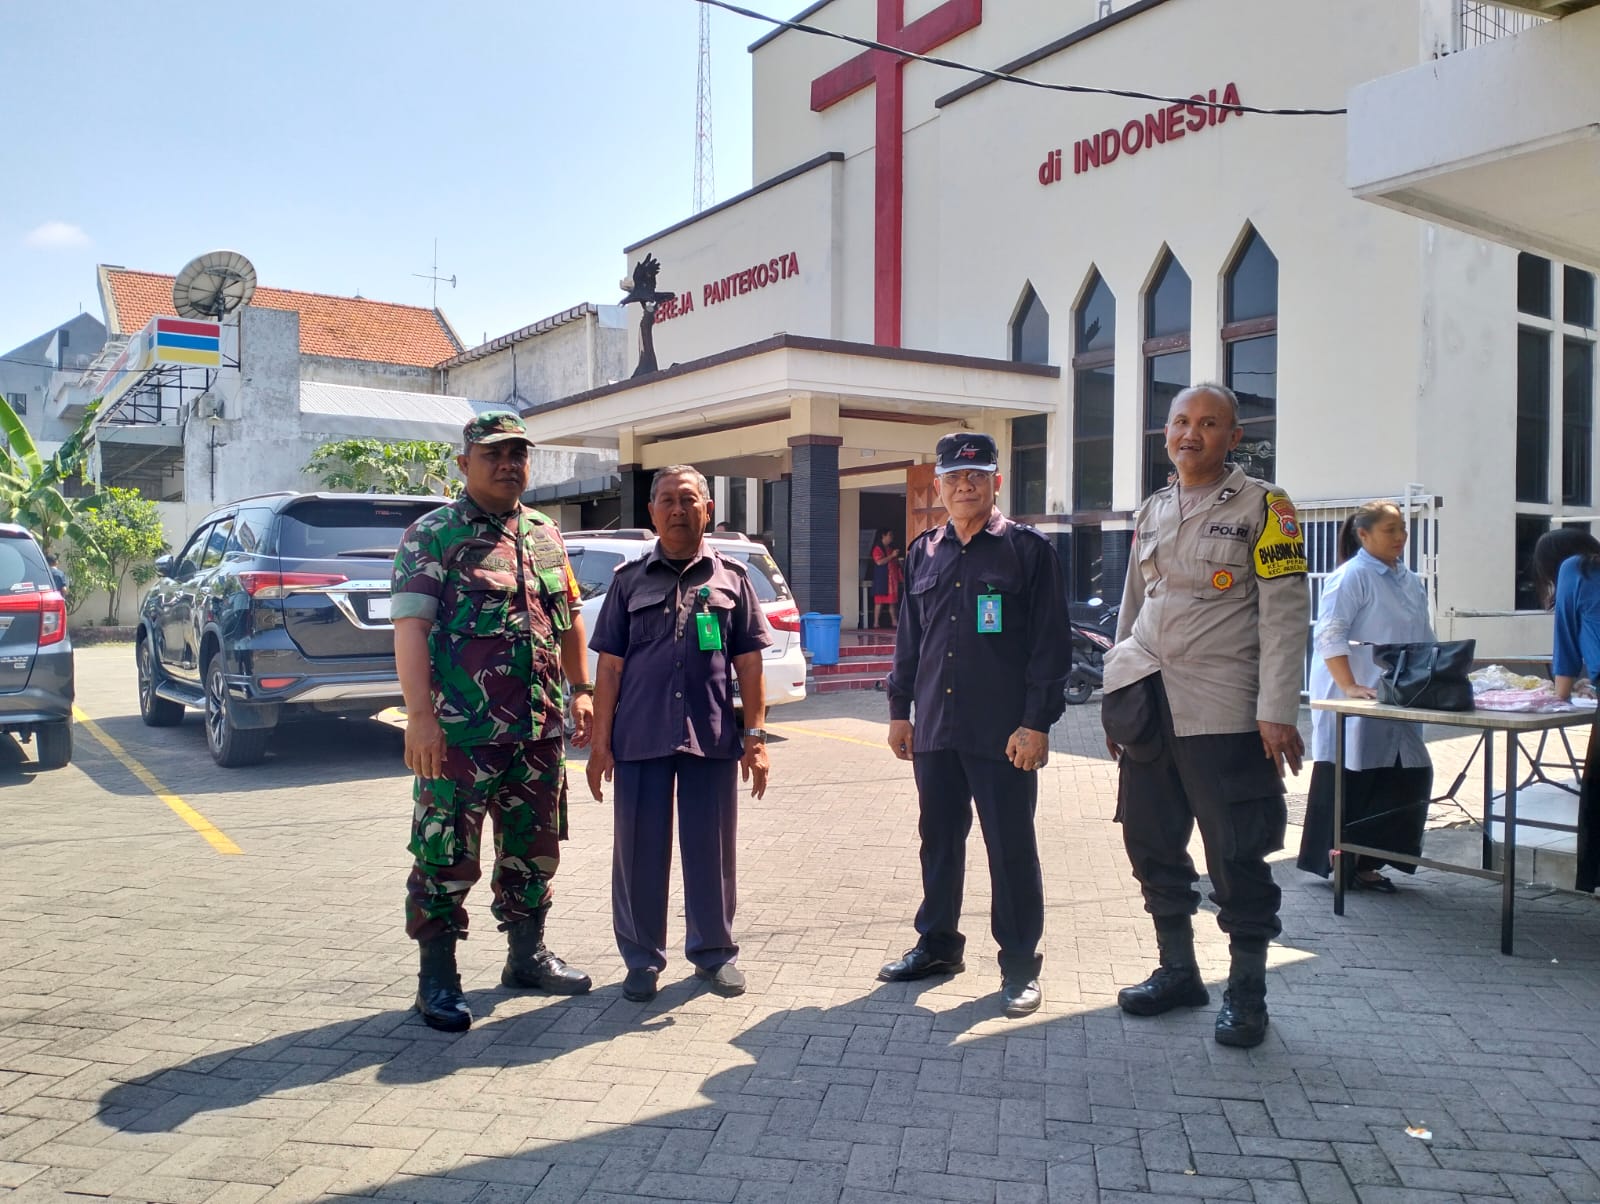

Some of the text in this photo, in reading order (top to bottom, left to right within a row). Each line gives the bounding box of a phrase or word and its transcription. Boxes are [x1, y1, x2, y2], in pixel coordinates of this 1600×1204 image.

[1038, 82, 1244, 186] di INDONESIA
[652, 251, 800, 324] EREJA PANTEKOSTA
[1210, 526, 1248, 538] POLRI
